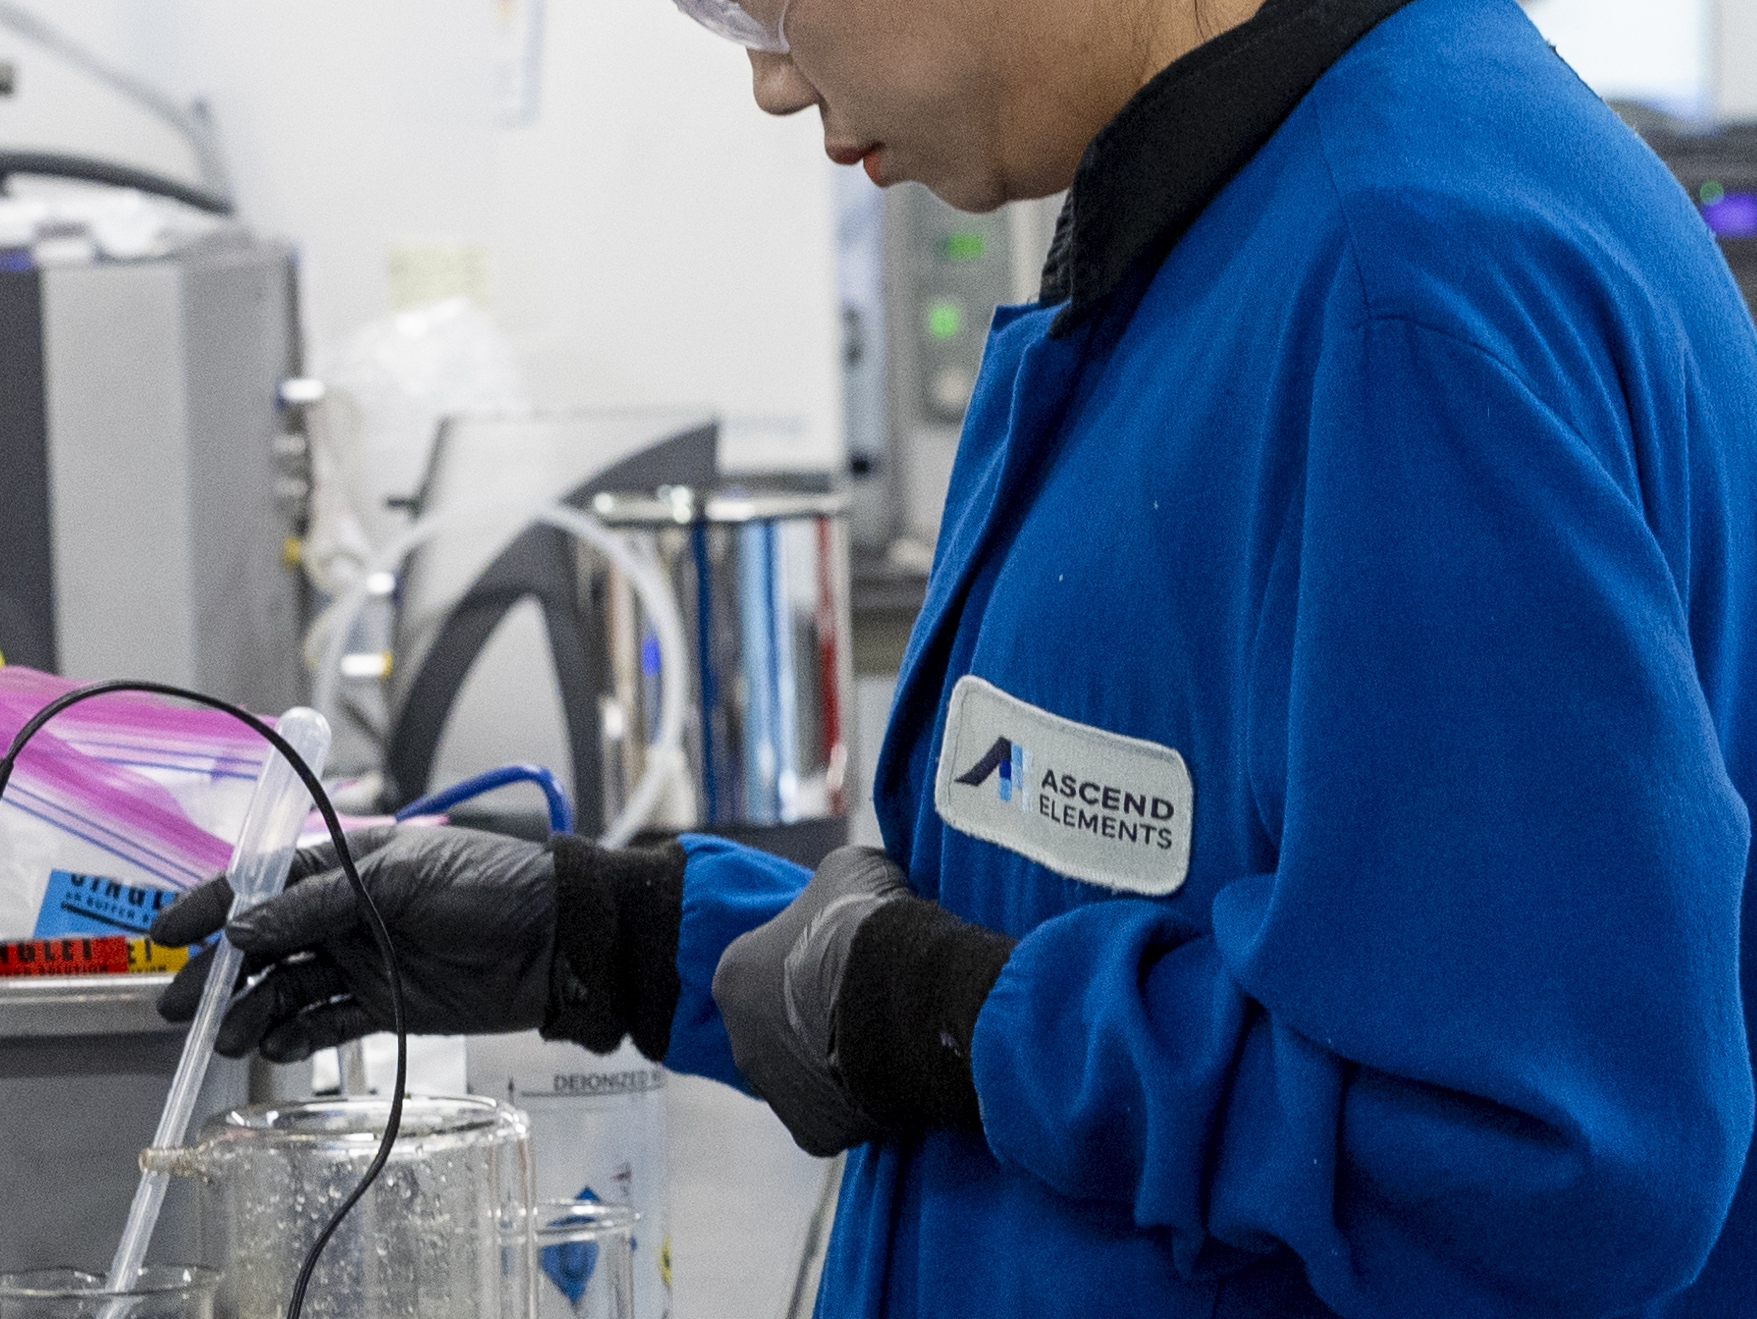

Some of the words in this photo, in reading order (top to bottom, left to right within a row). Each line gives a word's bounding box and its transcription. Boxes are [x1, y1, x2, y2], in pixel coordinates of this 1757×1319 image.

[1039, 793, 1174, 851] ELEMENTS
[1041, 768, 1175, 823] ASCEND
[553, 1070, 648, 1092] DEIONIZED
